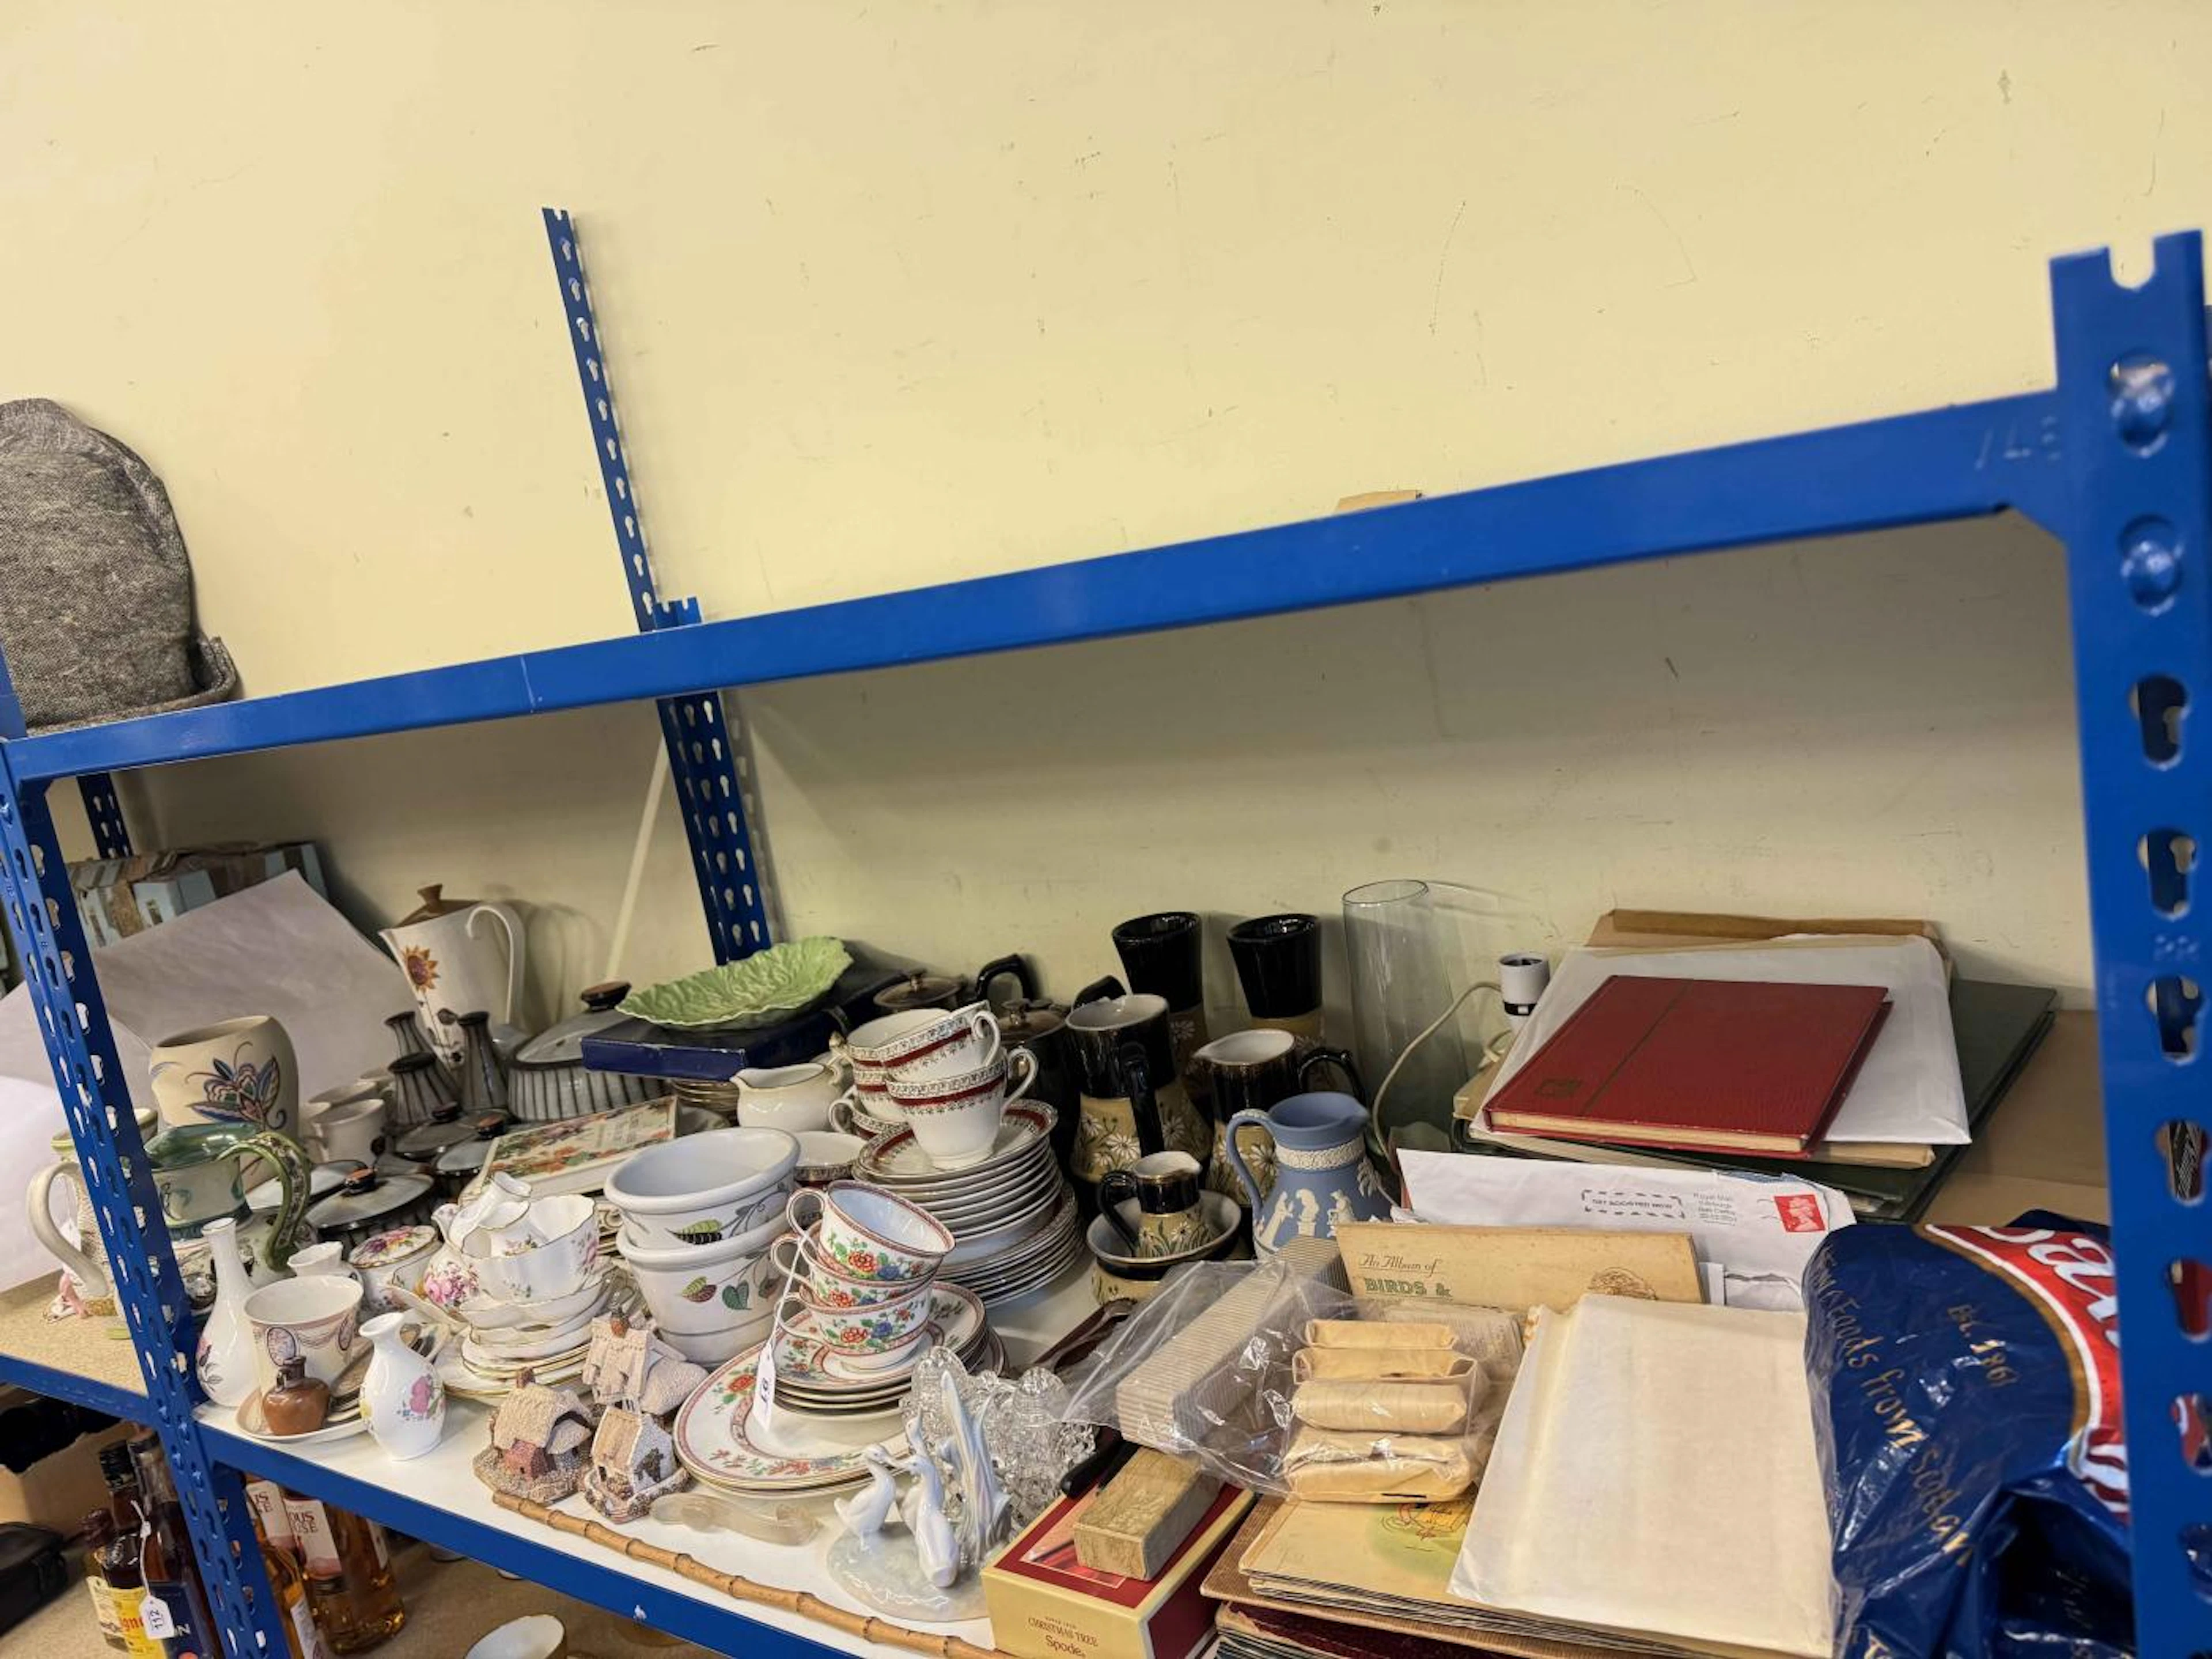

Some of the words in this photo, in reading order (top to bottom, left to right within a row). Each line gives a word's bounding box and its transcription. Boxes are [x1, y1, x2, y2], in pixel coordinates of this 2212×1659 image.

[1382, 1255, 1421, 1270] Album
[1425, 1258, 1444, 1278] of
[1364, 1277, 1427, 1296] BIRDS
[1827, 1296, 1884, 1369] Foods
[1861, 1367, 1929, 1449] from
[1908, 1446, 1974, 1567] Scotlan
[1074, 1632, 1099, 1647] TREE
